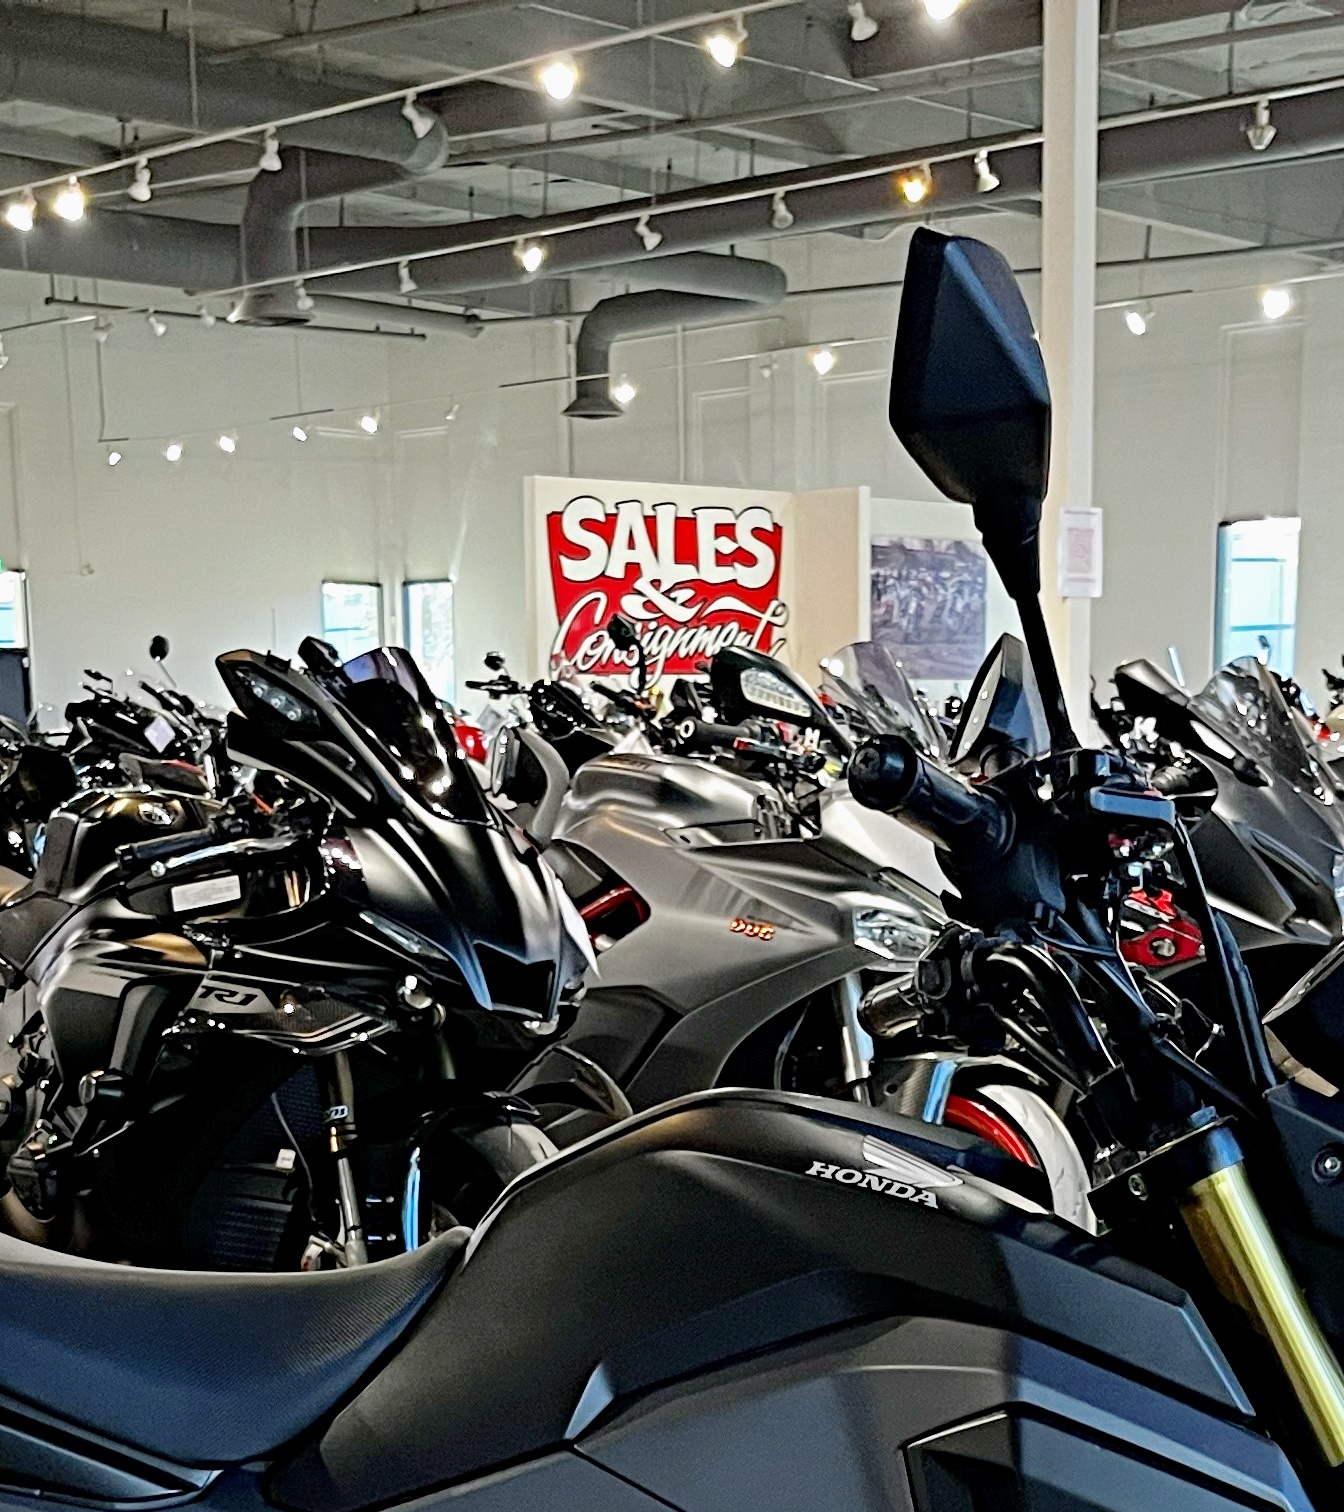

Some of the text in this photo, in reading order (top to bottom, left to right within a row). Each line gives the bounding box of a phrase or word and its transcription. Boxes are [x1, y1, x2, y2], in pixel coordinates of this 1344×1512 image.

[558, 494, 777, 589] SALES
[620, 578, 704, 623] &
[805, 1160, 939, 1210] HONDA
